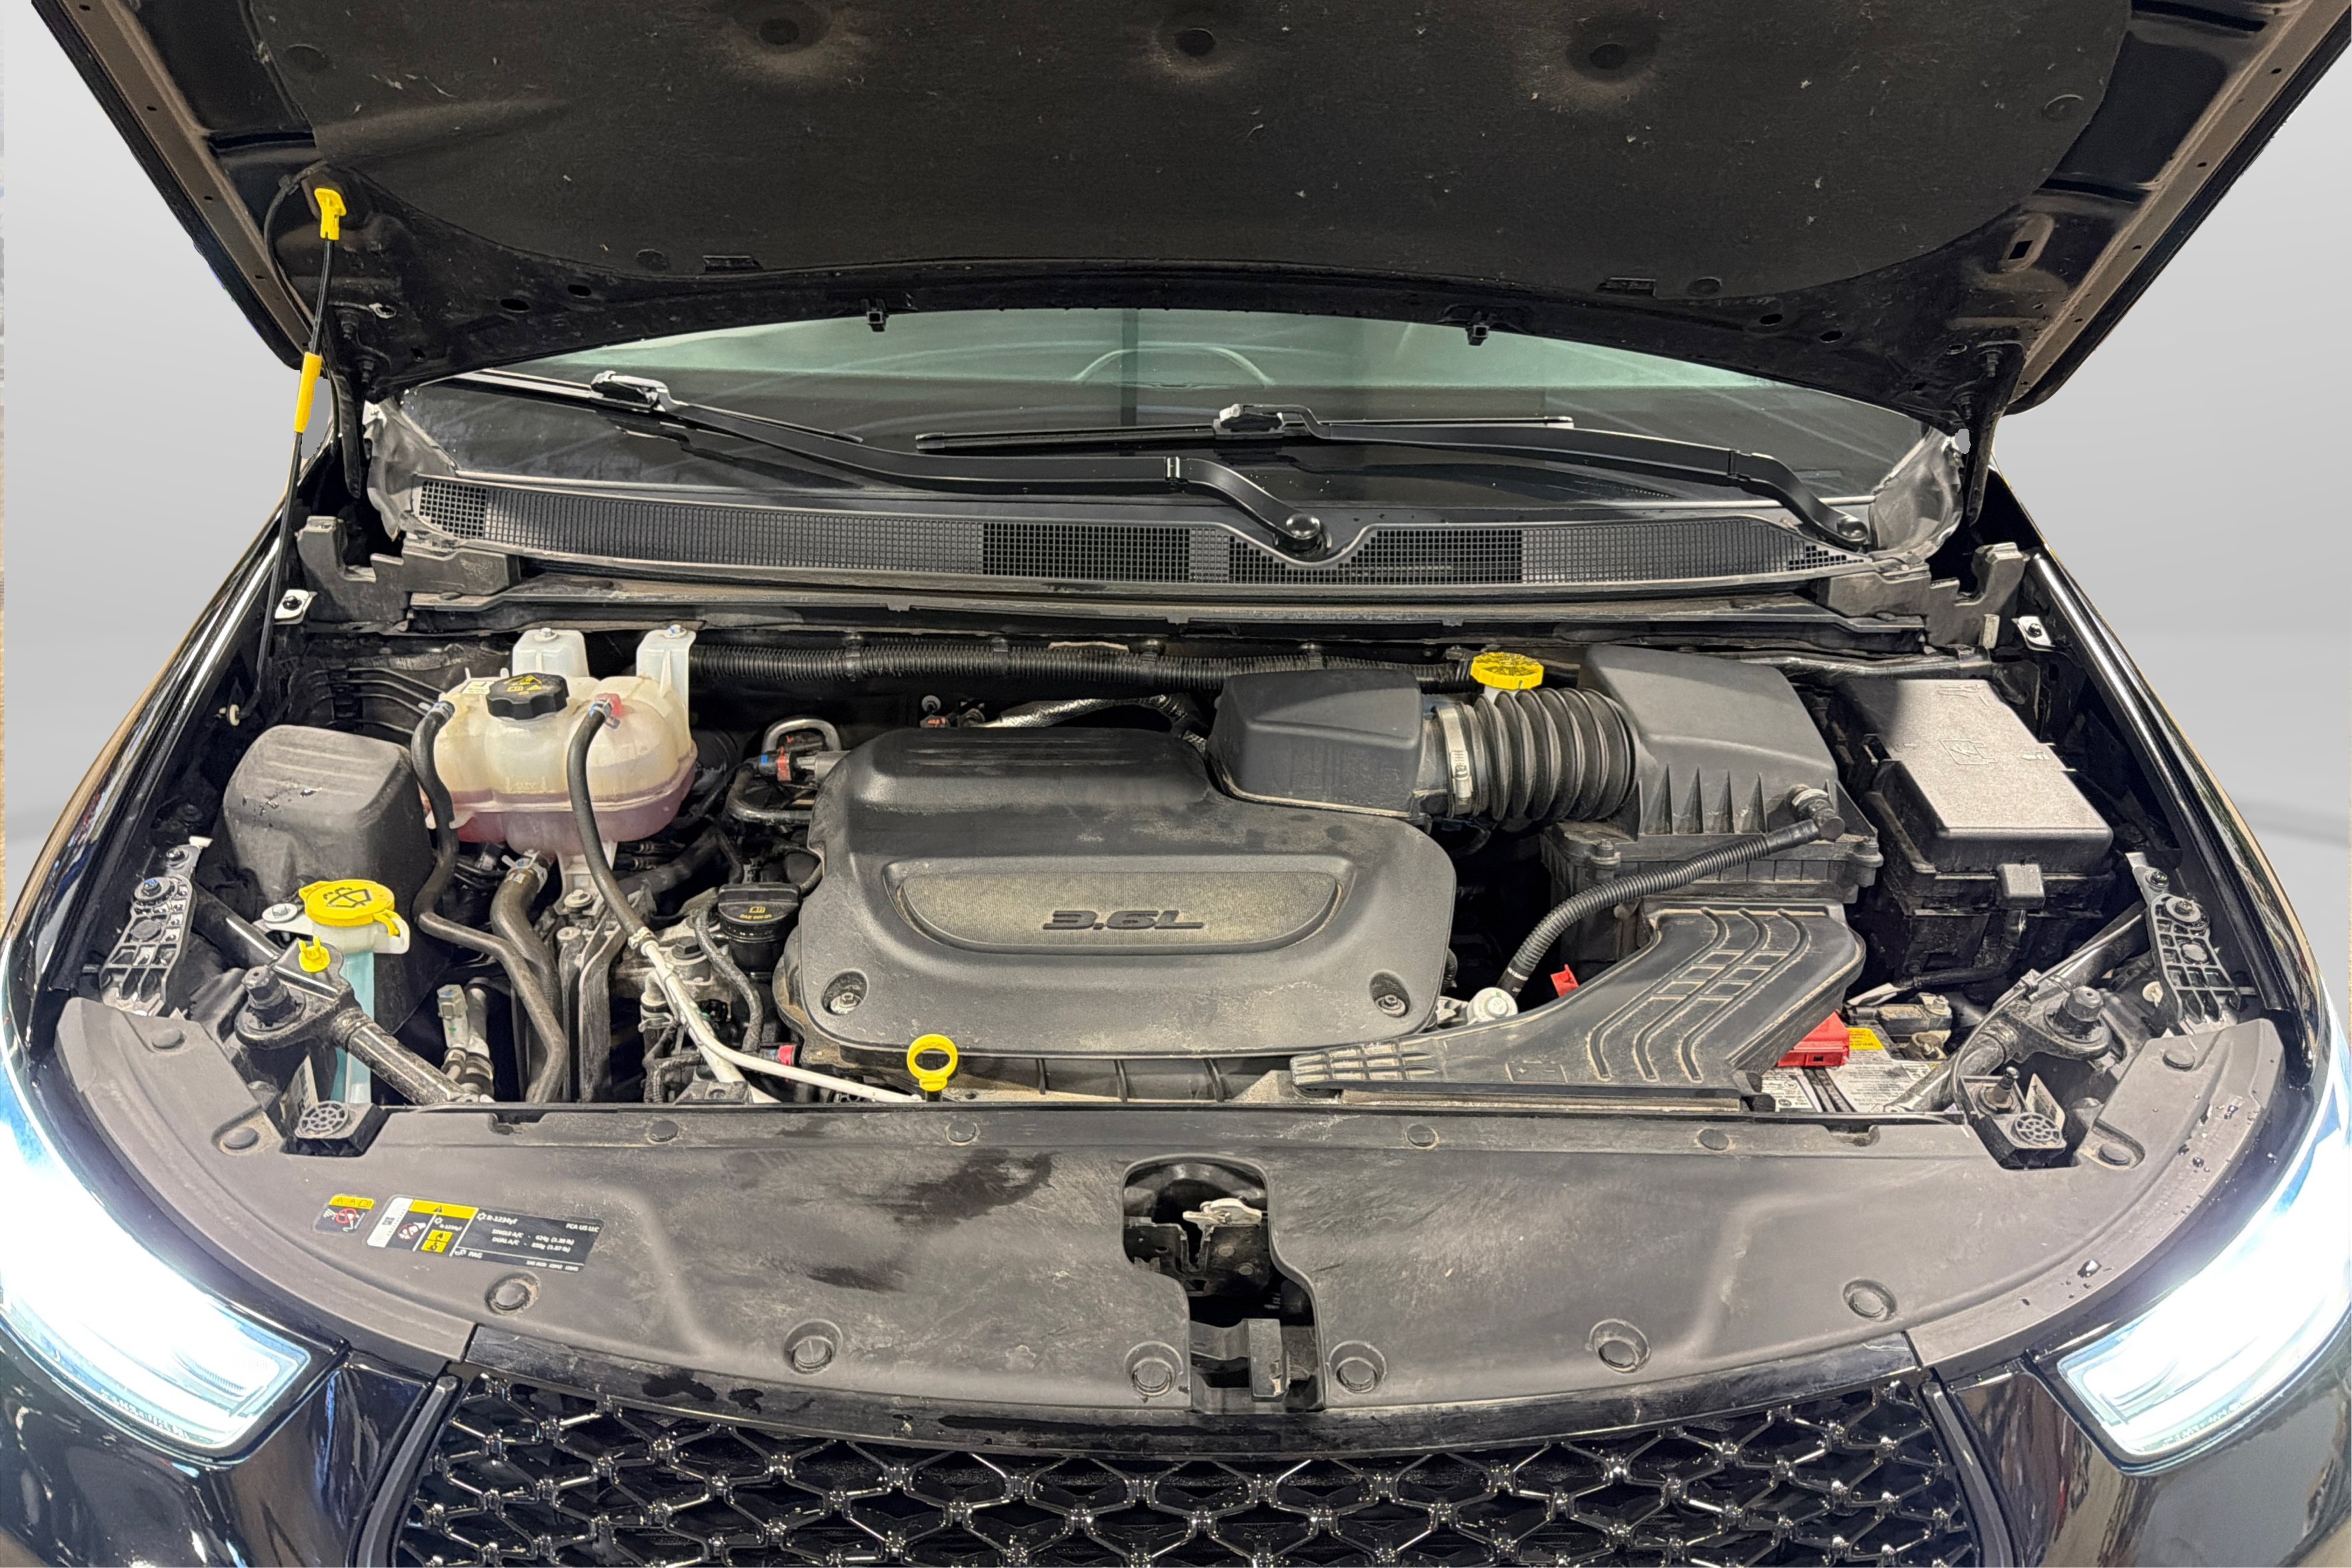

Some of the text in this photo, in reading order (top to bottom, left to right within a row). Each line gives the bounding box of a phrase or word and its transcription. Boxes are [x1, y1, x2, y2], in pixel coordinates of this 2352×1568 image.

[1043, 910, 1205, 930] 3.6L
[485, 1215, 519, 1225] R-1234yf
[565, 1223, 578, 1231] FCA
[491, 1228, 512, 1237] SINGLE
[512, 1231, 524, 1239] A/C
[507, 1238, 521, 1246] A/C
[467, 1251, 483, 1259] PAG
